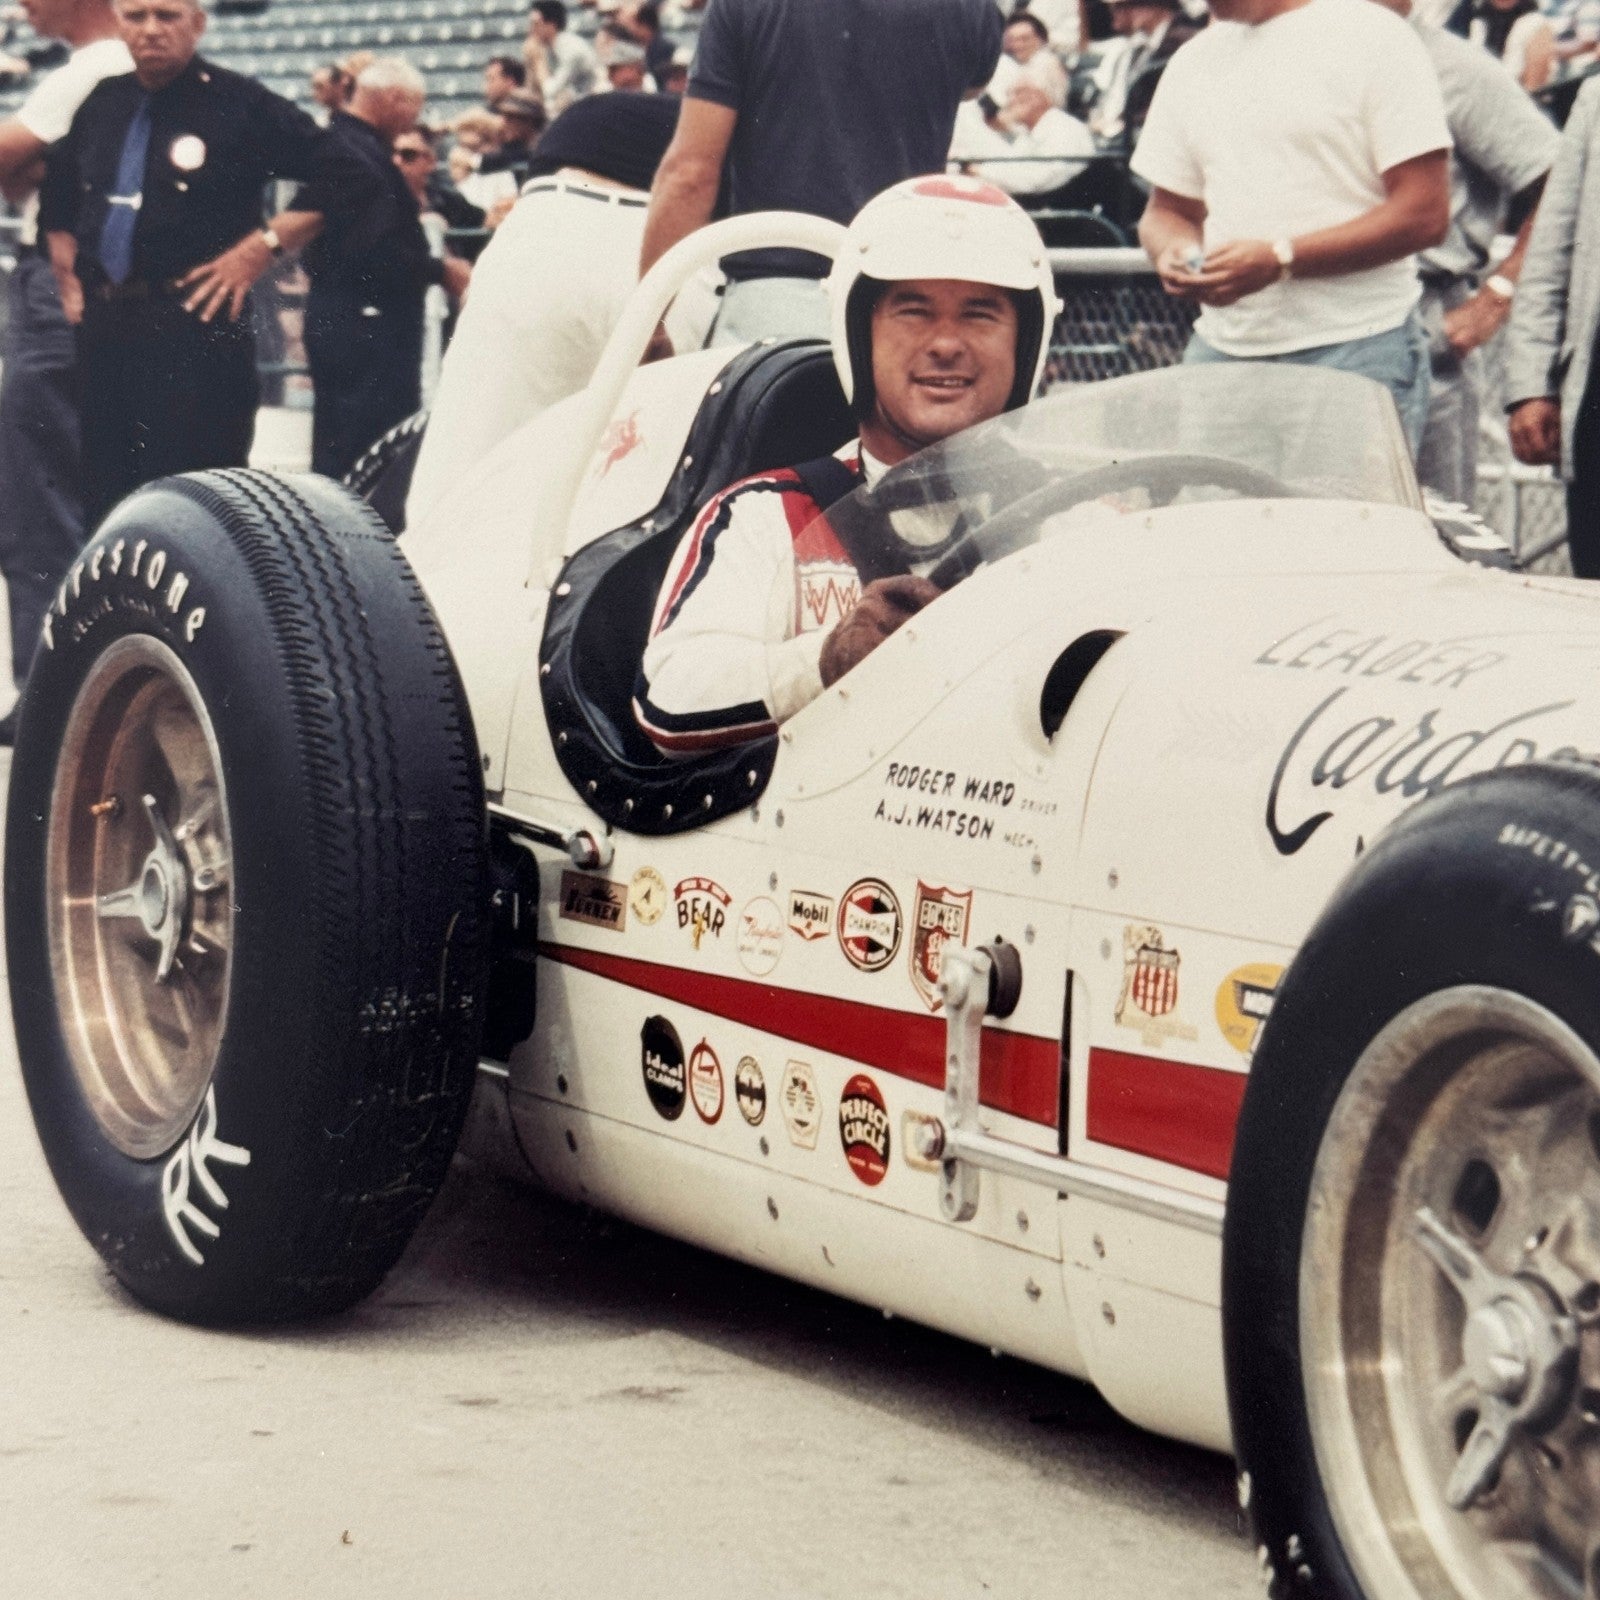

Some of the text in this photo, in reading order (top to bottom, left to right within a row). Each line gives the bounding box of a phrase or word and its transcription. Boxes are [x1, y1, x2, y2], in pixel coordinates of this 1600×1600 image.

[1253, 612, 1507, 689] LEADER
[886, 762, 956, 796] RODGER
[963, 778, 1016, 806] WARD
[677, 897, 726, 938] BEAR
[793, 901, 829, 923] Mobil
[848, 913, 891, 936] CHAMPION
[921, 902, 961, 933] BOWES
[840, 1097, 890, 1135] PERFECT
[844, 1121, 886, 1157] CIRCLE
